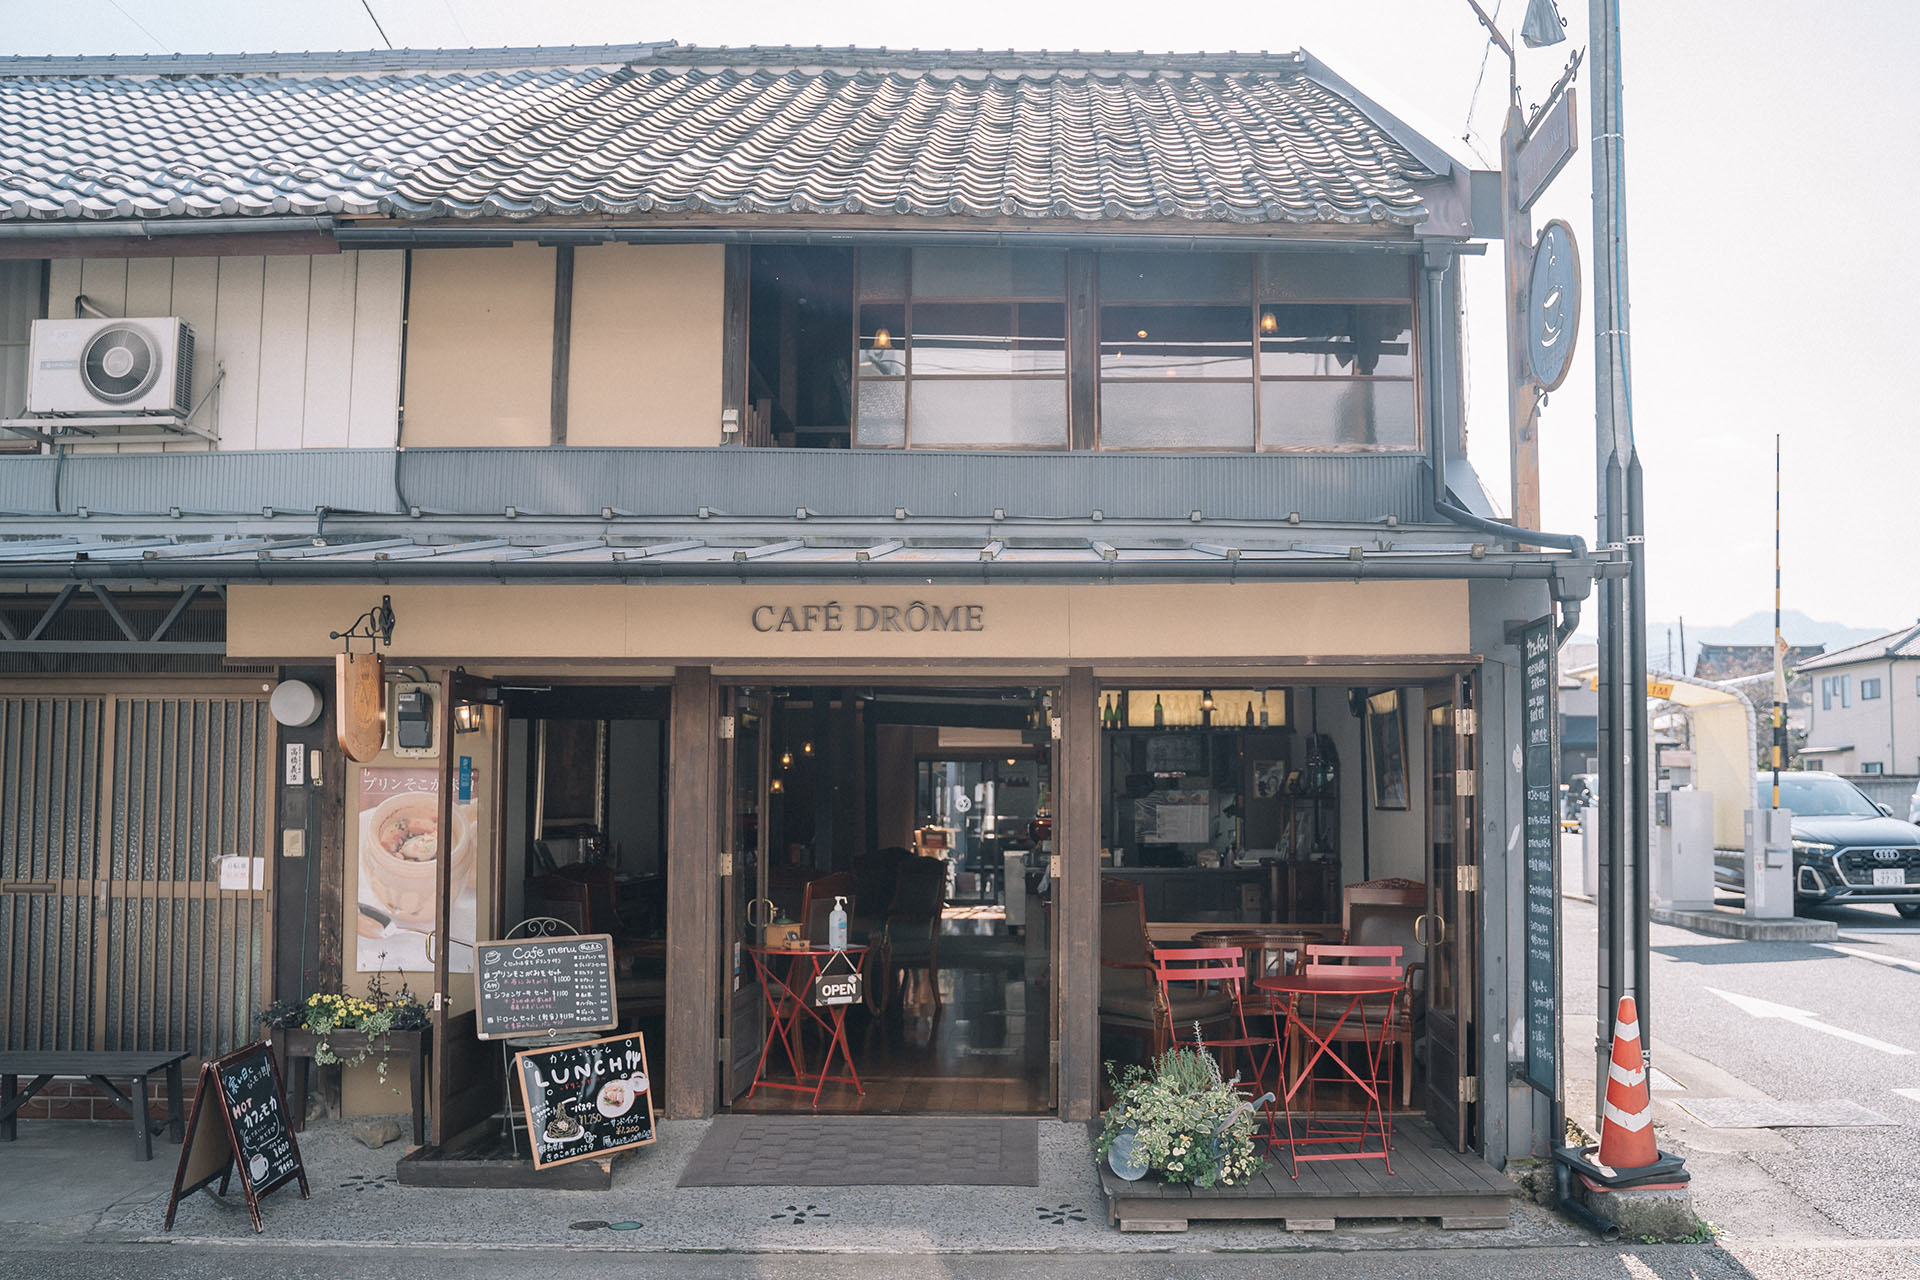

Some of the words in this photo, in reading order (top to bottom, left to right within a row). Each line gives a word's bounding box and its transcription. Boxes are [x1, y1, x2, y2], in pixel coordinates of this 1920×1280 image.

[751, 601, 843, 632] CAFÉ
[854, 601, 984, 632] DRÔME
[512, 946, 545, 960] Cafe
[547, 945, 577, 955] menu
[821, 983, 857, 997] OPEN
[534, 1056, 623, 1088] LUNCH
[232, 1098, 253, 1120] HOT
[243, 1095, 278, 1129] カフェモカ
